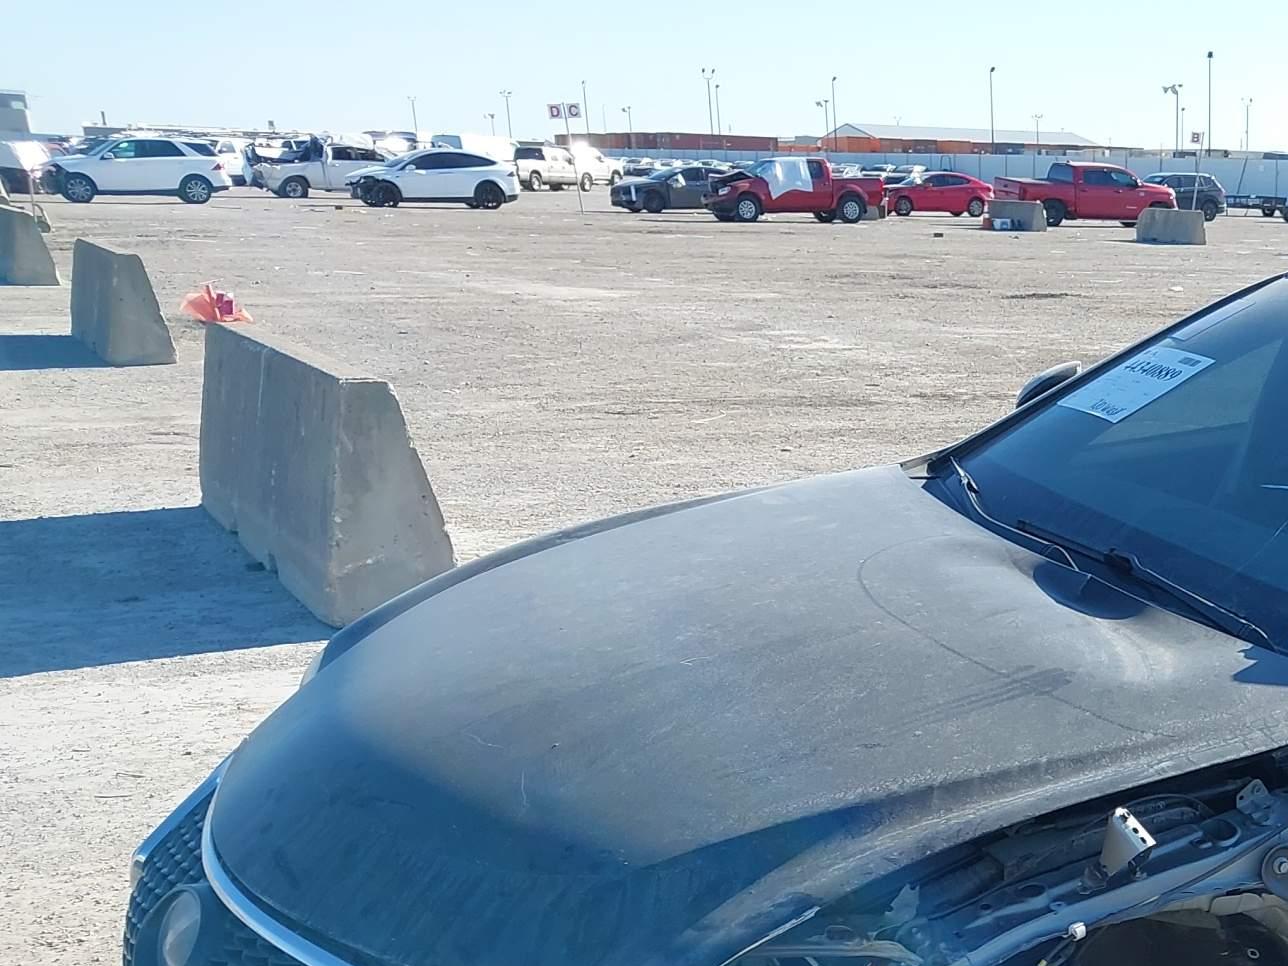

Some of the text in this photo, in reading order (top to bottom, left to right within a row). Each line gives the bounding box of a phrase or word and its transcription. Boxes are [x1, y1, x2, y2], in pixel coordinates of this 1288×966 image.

[550, 106, 560, 117] D
[569, 105, 578, 117] C
[1191, 132, 1200, 143] B
[1124, 359, 1183, 381] 44340889
